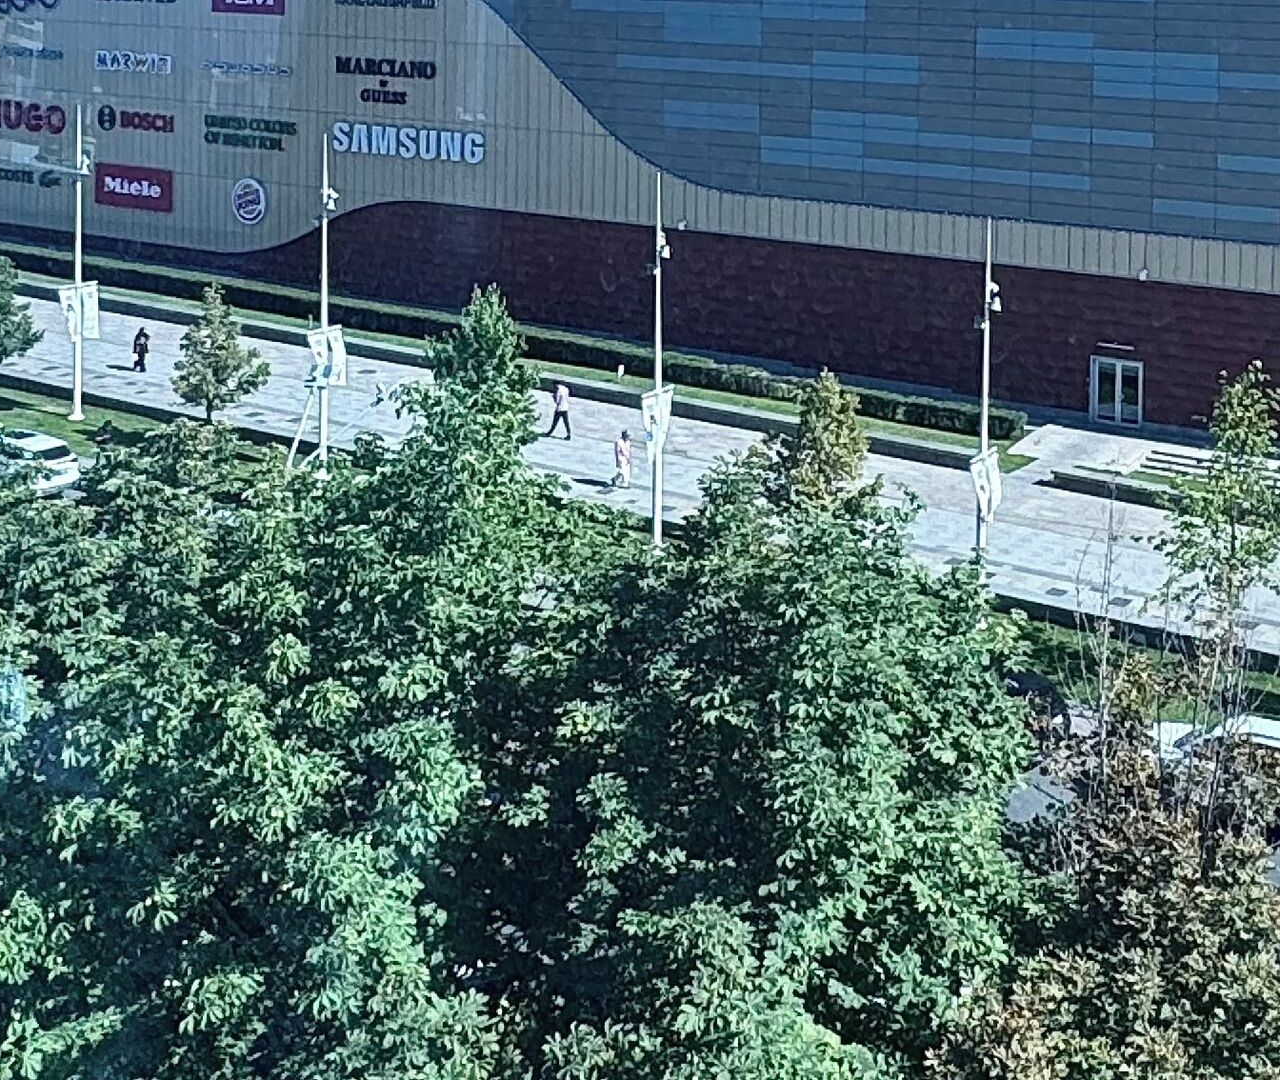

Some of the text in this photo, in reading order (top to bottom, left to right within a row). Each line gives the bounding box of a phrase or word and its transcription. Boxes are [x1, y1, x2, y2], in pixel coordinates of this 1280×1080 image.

[335, 55, 438, 80] MARCIANO
[360, 88, 408, 105] GUESS
[120, 110, 175, 133] BOSCH
[332, 122, 484, 164] SAMSUNG
[104, 176, 162, 198] Miele
